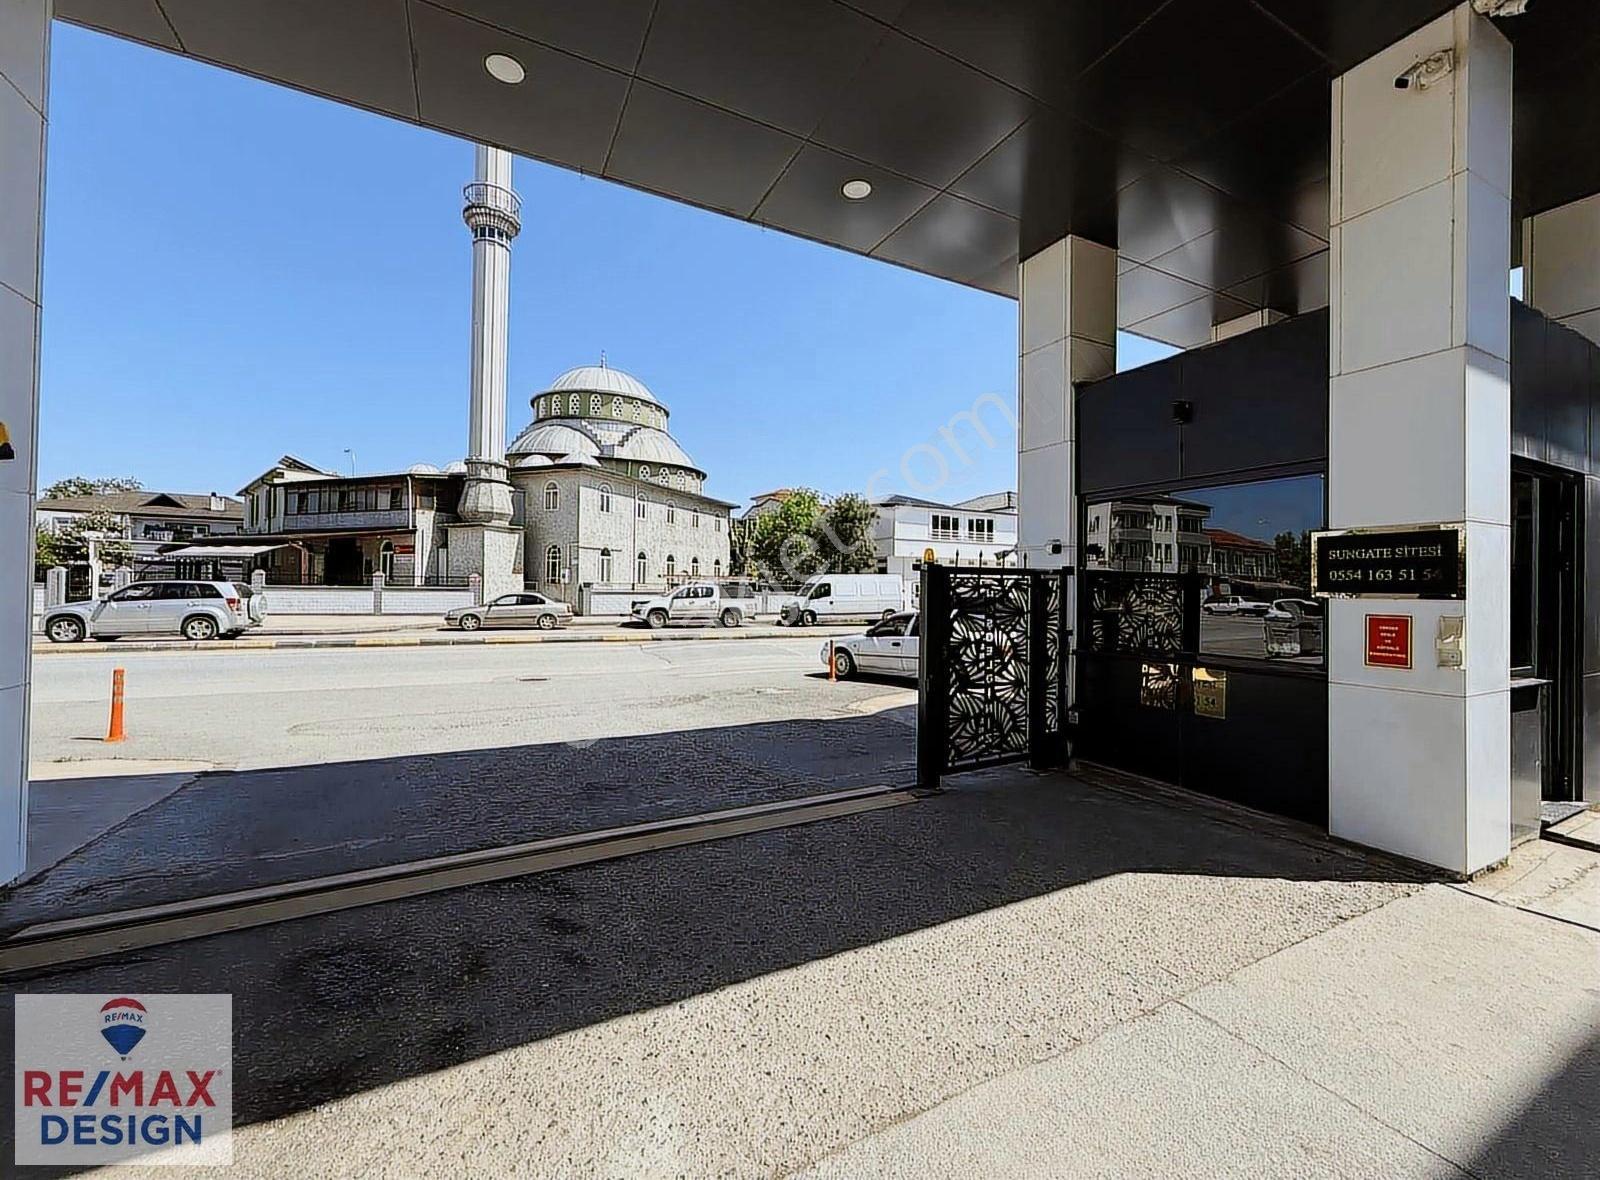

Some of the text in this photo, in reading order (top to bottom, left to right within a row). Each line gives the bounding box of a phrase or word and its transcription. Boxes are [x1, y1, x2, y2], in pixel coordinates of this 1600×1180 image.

[1328, 548, 1392, 560] SUNGATE
[1329, 569, 1362, 581] 0554
[1368, 569, 1393, 581] 163
[1398, 568, 1417, 581] 51
